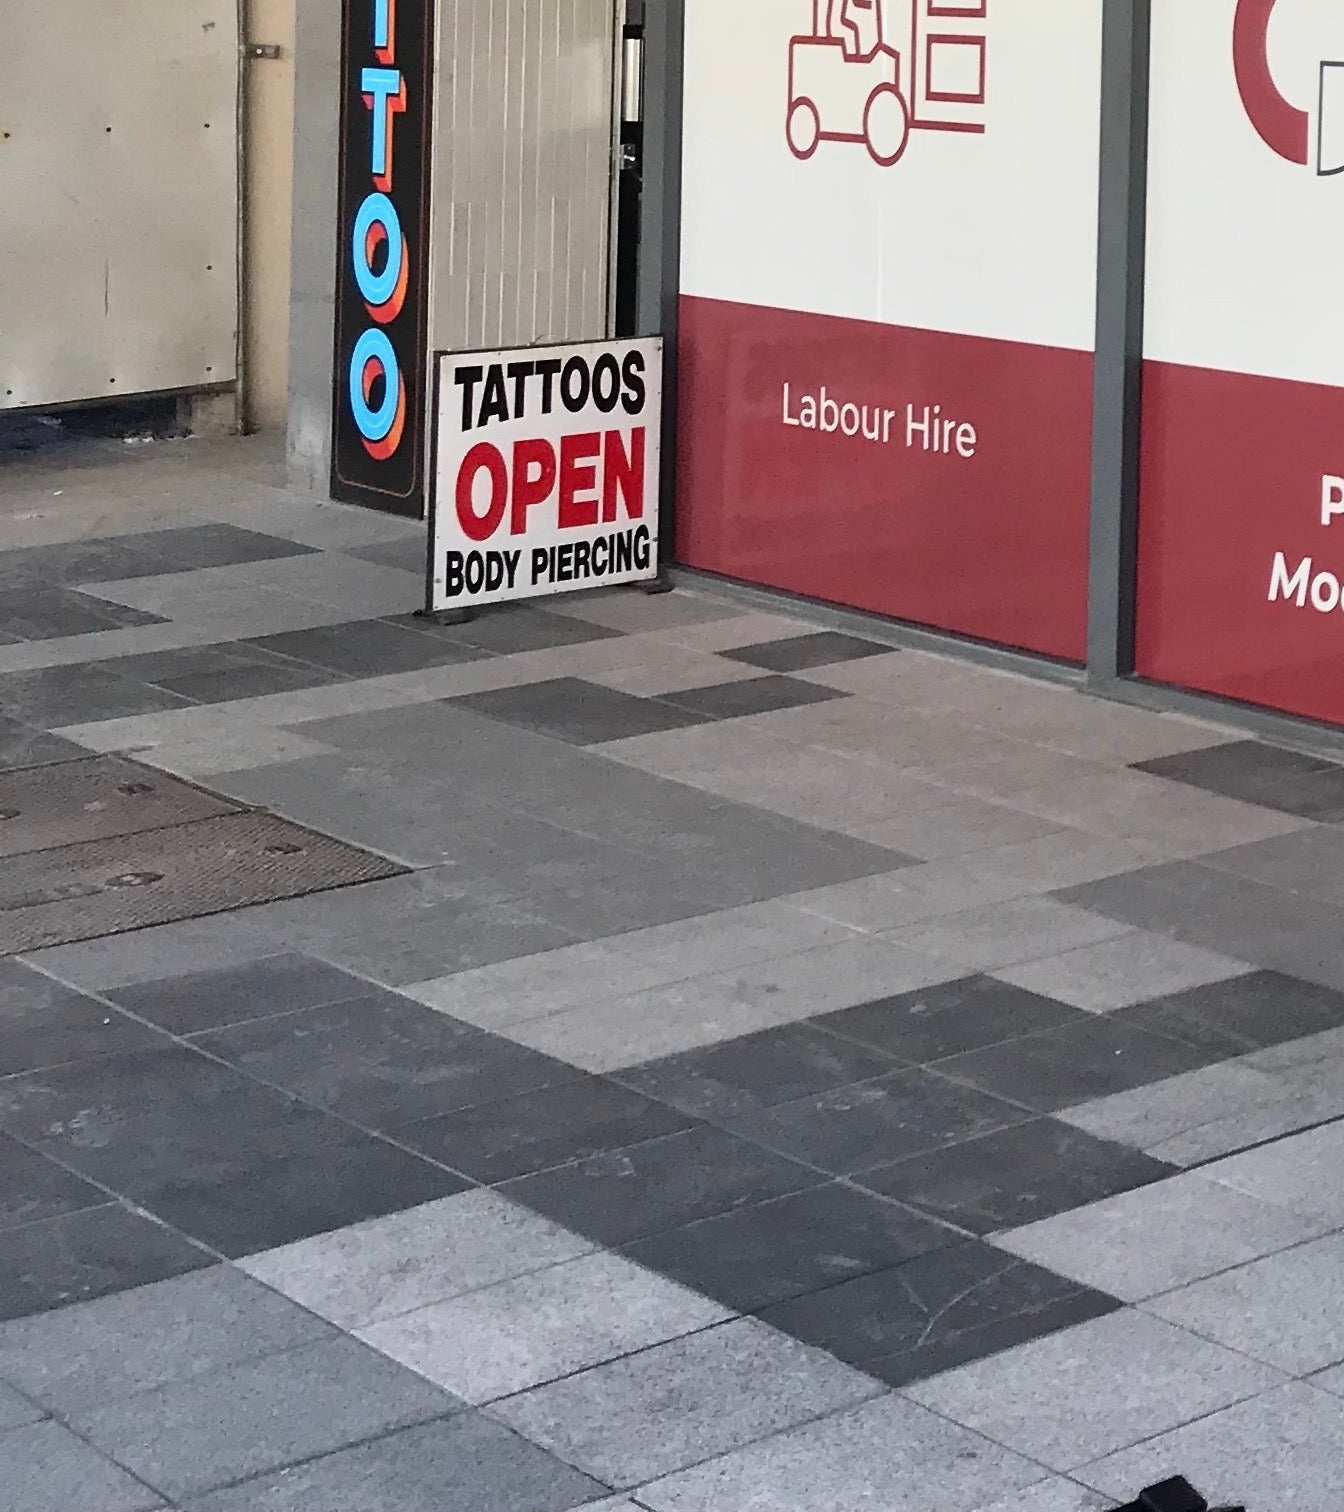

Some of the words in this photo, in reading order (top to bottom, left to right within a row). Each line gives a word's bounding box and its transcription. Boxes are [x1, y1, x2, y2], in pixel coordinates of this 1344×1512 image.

[454, 349, 646, 432] TATTOOS
[783, 382, 895, 442] Labour
[906, 403, 976, 458] Hire
[455, 426, 646, 542] OPEN
[446, 549, 521, 598] BODY
[531, 523, 650, 585] PIERCING
